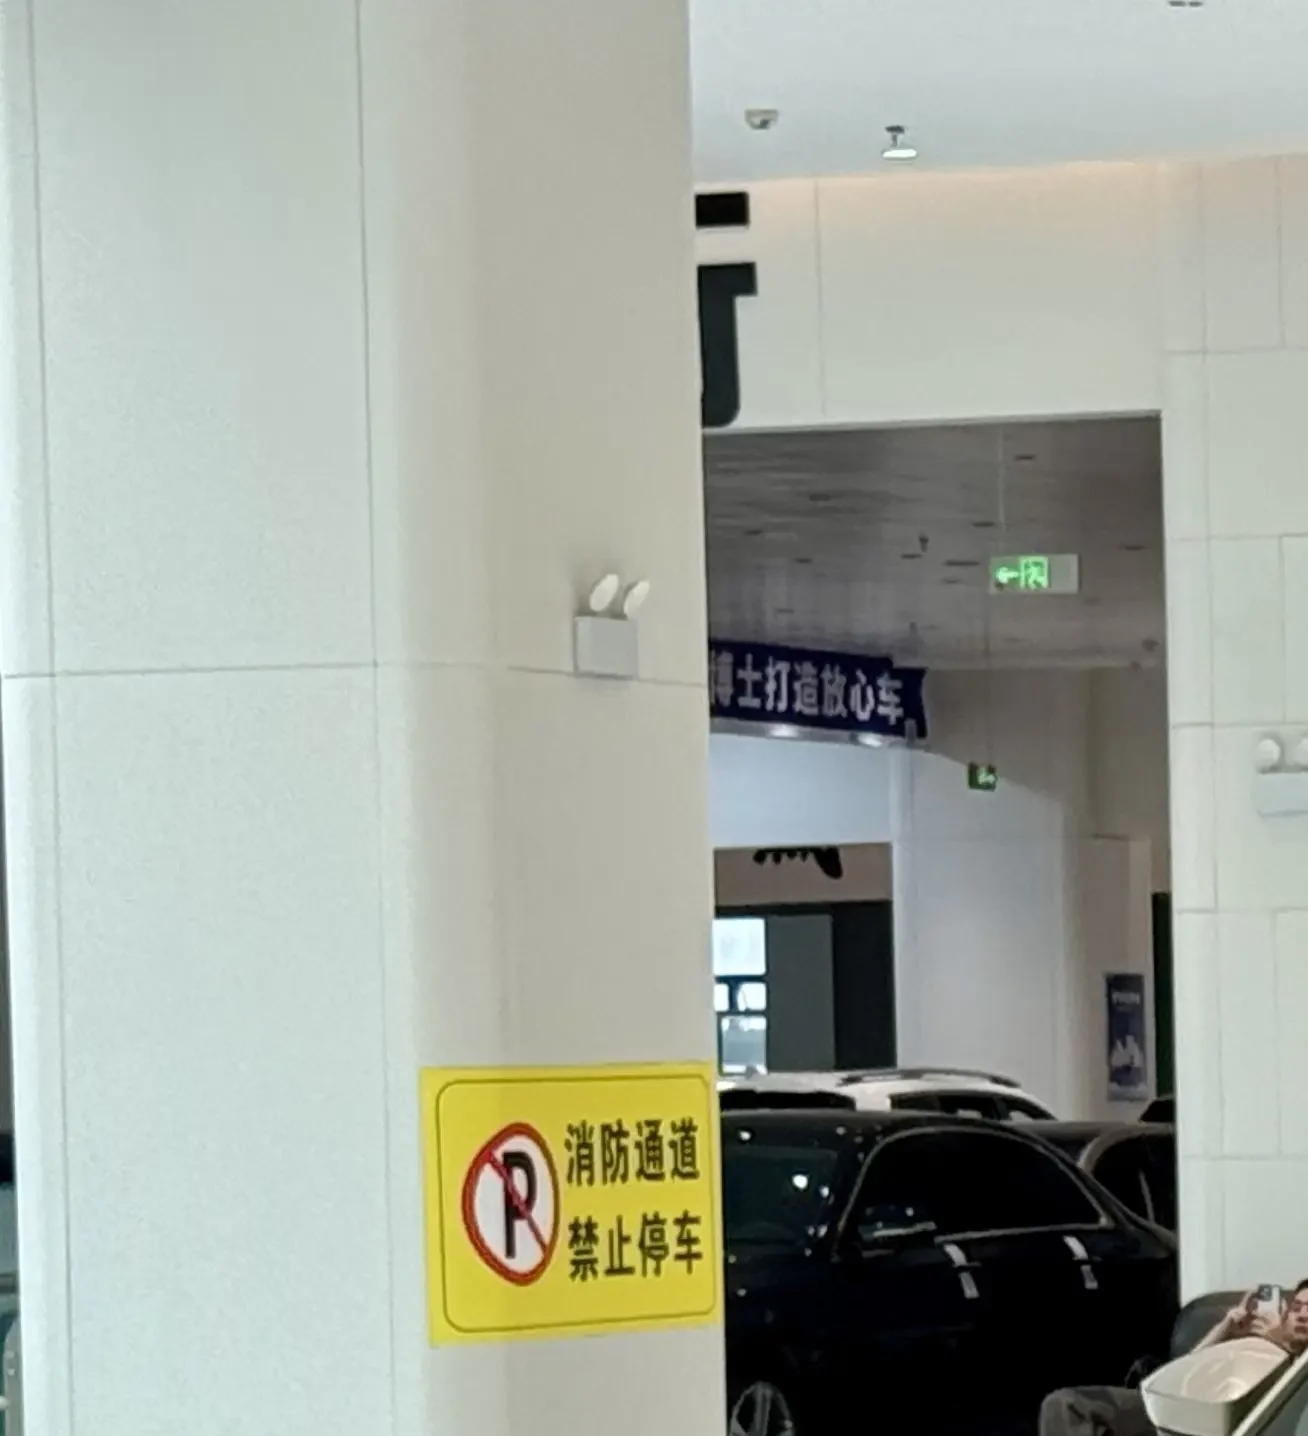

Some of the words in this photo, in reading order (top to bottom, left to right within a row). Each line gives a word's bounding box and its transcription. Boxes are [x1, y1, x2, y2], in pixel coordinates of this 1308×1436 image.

[564, 1118, 700, 1186] 消防通道
[568, 1210, 703, 1281] 禁止停车
